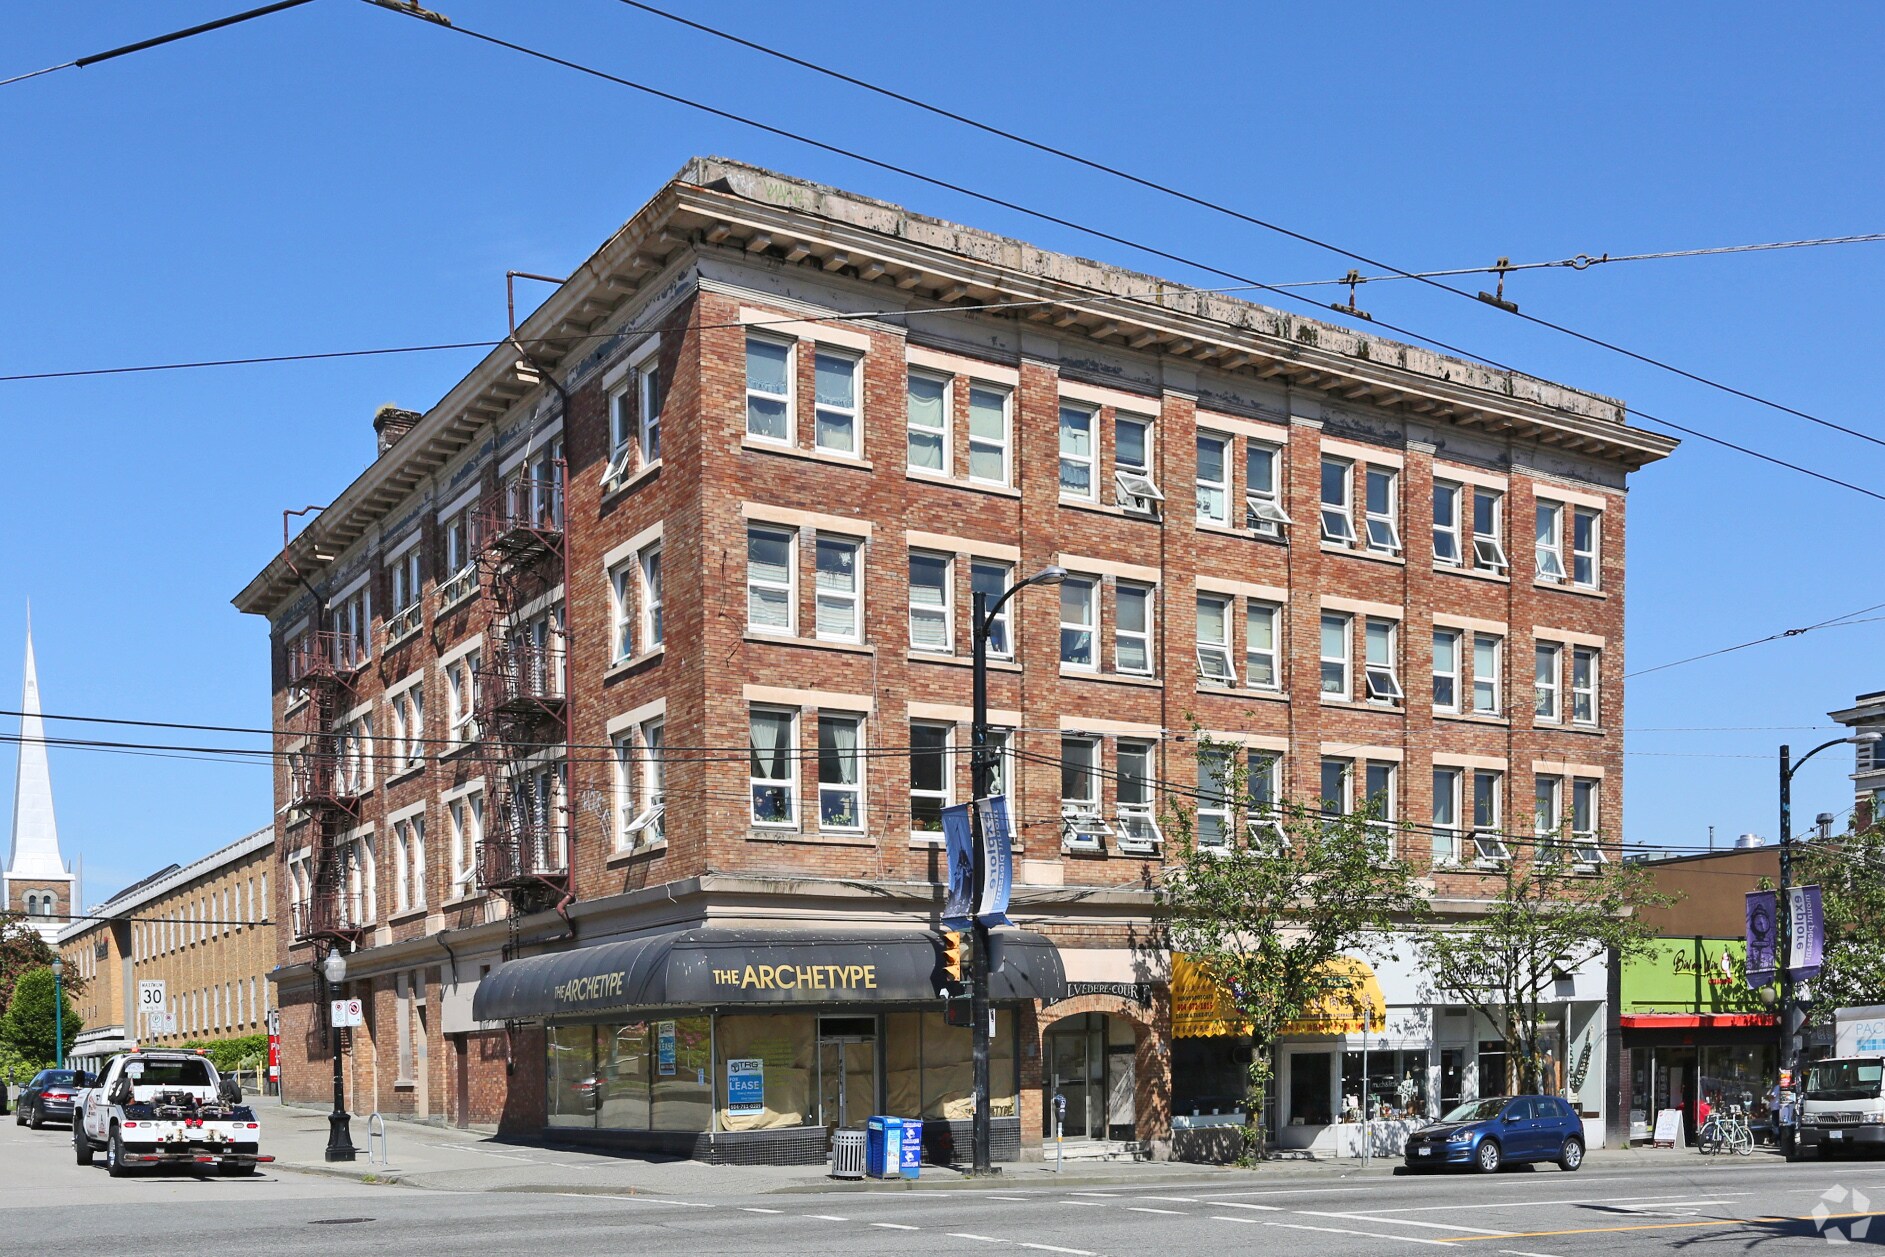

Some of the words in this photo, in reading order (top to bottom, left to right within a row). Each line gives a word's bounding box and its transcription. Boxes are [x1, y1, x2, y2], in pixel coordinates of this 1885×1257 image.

[554, 985, 566, 999] THE
[563, 971, 626, 1003] ARCHETYPE
[712, 969, 740, 985] THE
[740, 964, 877, 990] ARCHETYPE
[143, 989, 162, 1004] 30
[730, 1080, 760, 1090] LEASE
